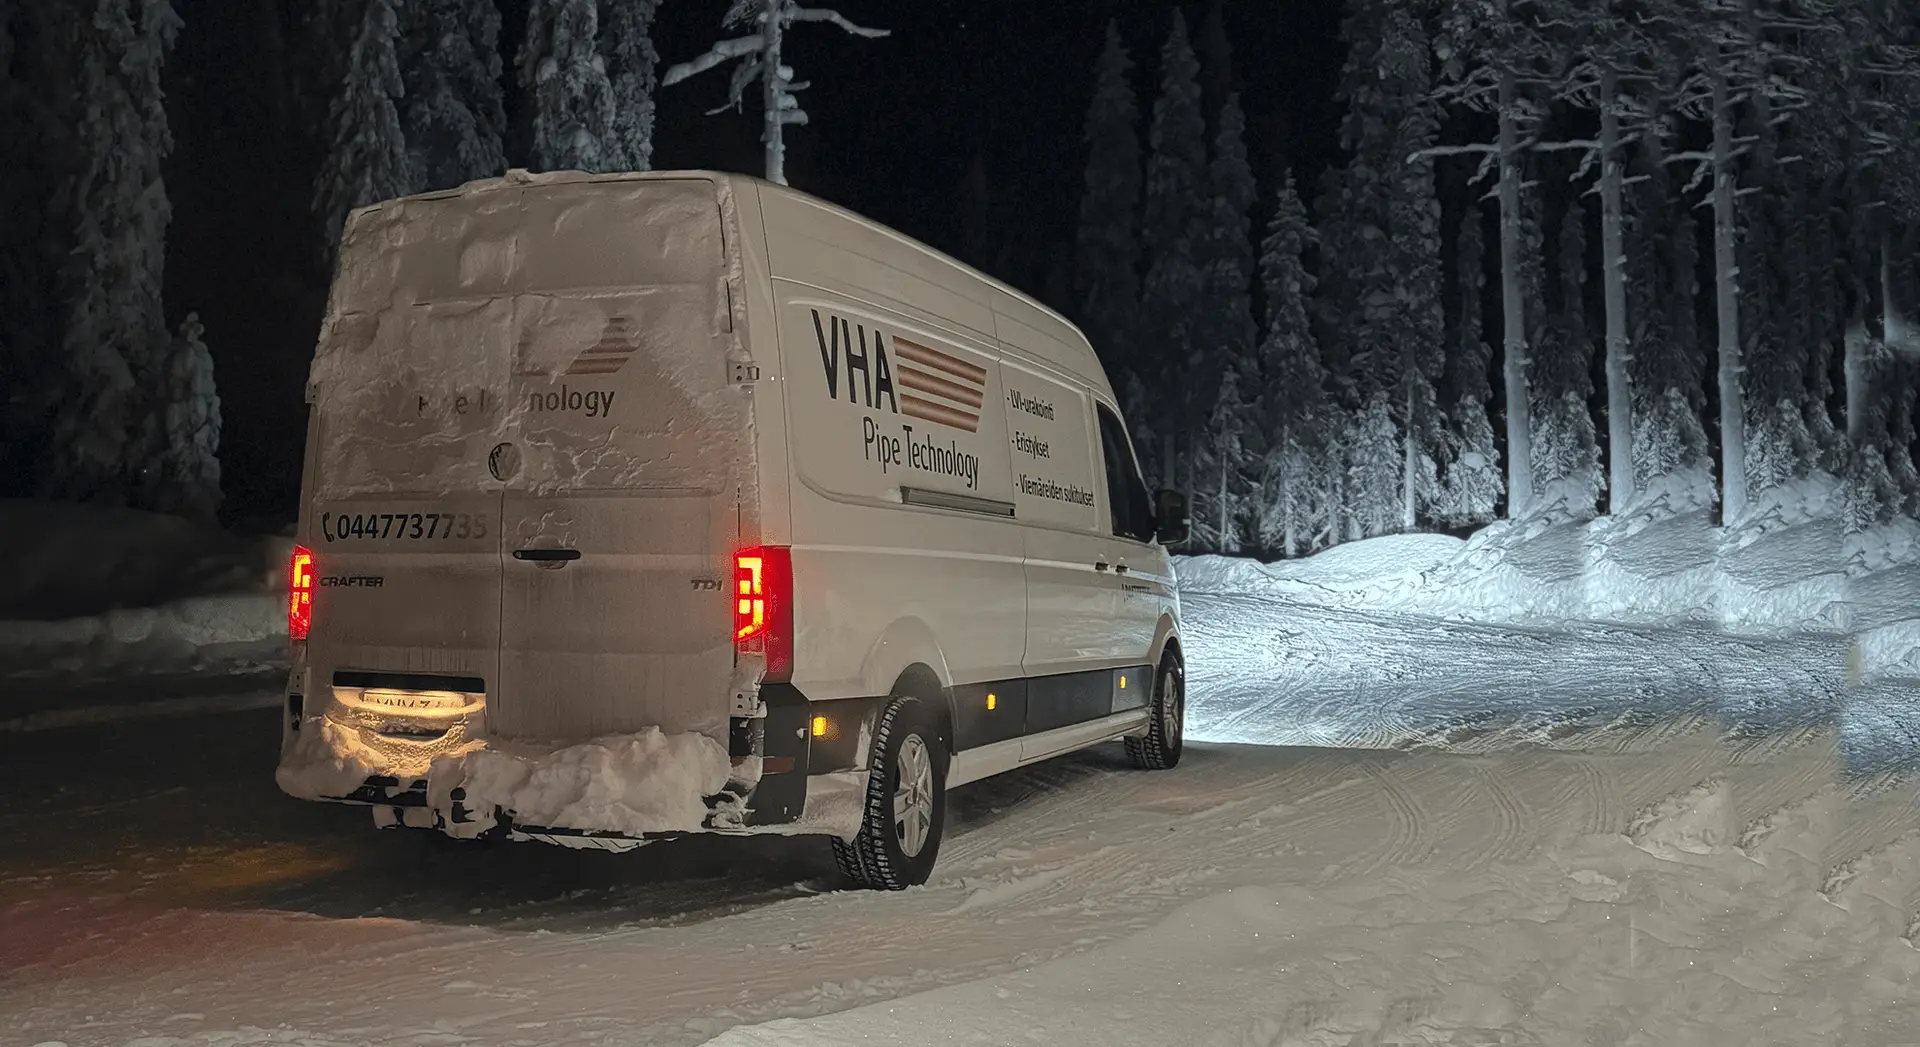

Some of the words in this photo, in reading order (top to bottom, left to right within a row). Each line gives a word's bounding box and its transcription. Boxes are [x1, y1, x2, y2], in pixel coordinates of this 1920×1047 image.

[811, 308, 898, 414] VHA
[863, 416, 901, 474] Pipe
[902, 424, 979, 491] Technology
[1016, 431, 1050, 460] Eristykset
[1019, 473, 1063, 502] Viemäreiden
[337, 513, 488, 539] 0447737735
[319, 576, 384, 588] CRAFTER
[690, 579, 723, 591] TDI
